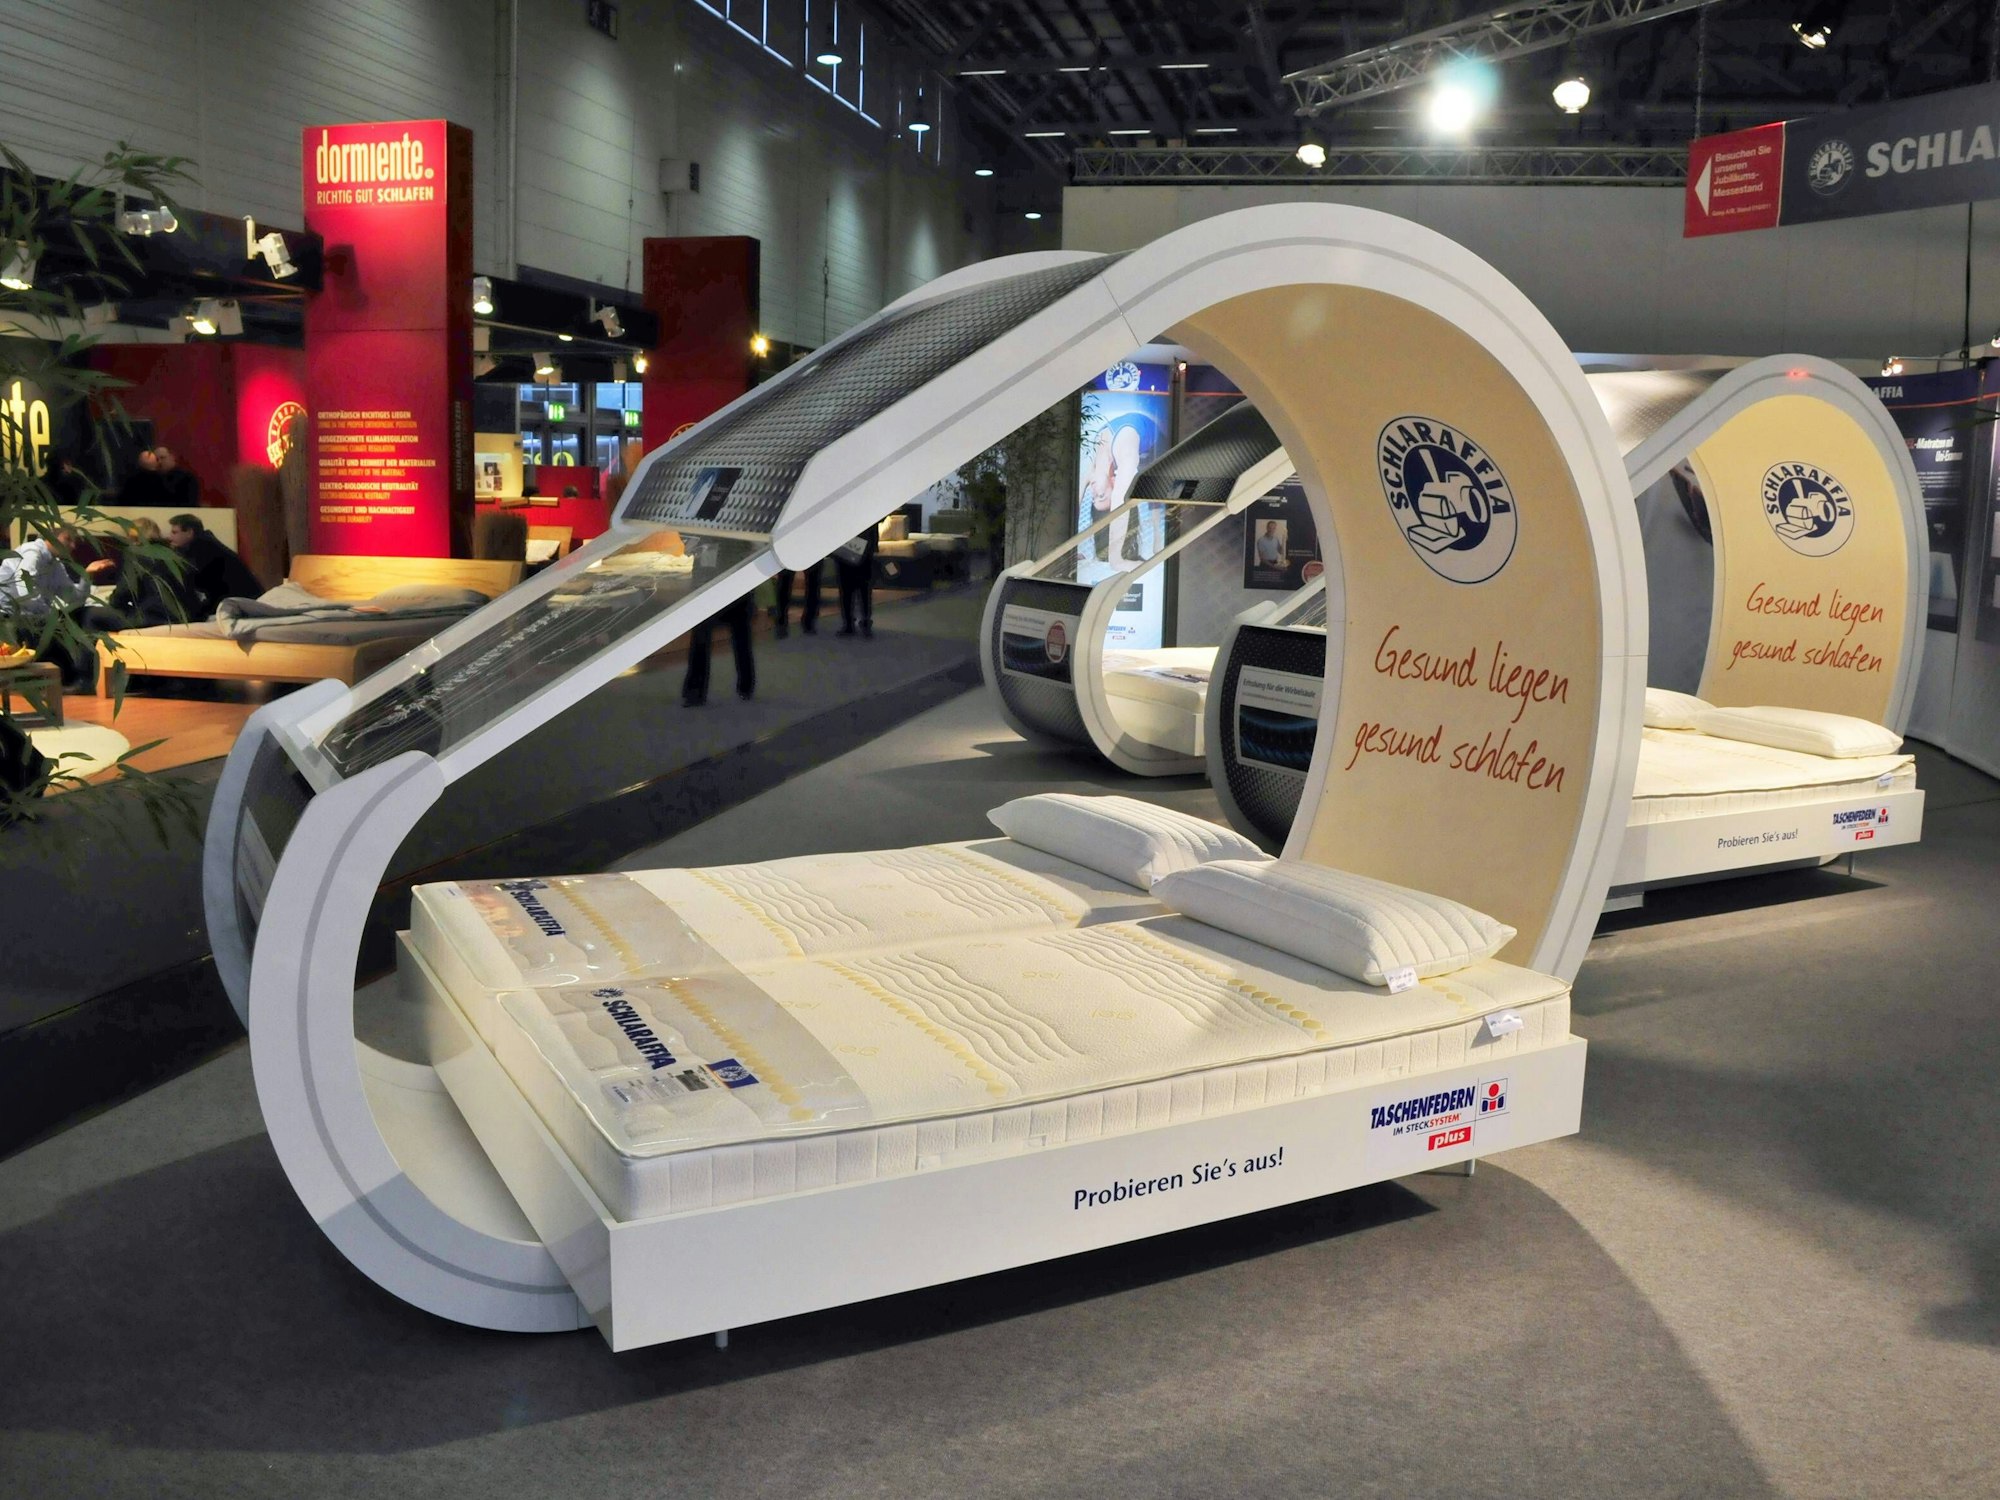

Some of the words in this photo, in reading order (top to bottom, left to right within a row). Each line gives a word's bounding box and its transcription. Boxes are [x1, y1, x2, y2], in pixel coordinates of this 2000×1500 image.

[316, 129, 434, 184] dormiente.
[1714, 162, 1748, 173] unseren
[1715, 148, 1757, 162] Besuchen
[1757, 145, 1772, 156] Sie
[1865, 125, 2000, 178] SCHLA
[317, 190, 352, 204] RICHTIG
[355, 188, 373, 203] GUT
[377, 186, 434, 203] SCHLAFEN
[1713, 171, 1760, 185] Jubiläums-
[1713, 182, 1764, 197] Messestand
[1383, 422, 1511, 515] SCHLARAFFIA
[1764, 464, 1851, 517] SCHLARAFFIA
[1747, 583, 1820, 618] Gesund
[1829, 589, 1883, 635] liegen
[1375, 625, 1477, 687] Gesund
[1489, 641, 1568, 723] liegen
[1727, 639, 1797, 670] gesund
[1803, 639, 1882, 672] schlafen
[1345, 723, 1442, 771] gesund
[1450, 728, 1565, 793] schlafen
[1833, 808, 1877, 825] TASCHENFEDERN
[1718, 834, 1760, 848] Probieren
[1762, 831, 1780, 843] Sie's
[1782, 829, 1798, 841] aus!
[510, 890, 566, 936] SCHLARAFFIA
[602, 1000, 677, 1070] SCHLARAFFIA
[1371, 1086, 1475, 1129] TASCHENFEDERN
[1393, 1127, 1403, 1136] IM
[1406, 1114, 1461, 1133] STECKSYSTEM
[1432, 1129, 1465, 1150] plus
[1074, 1173, 1183, 1210] Probieren
[1191, 1158, 1236, 1184] Sie's
[1243, 1146, 1283, 1173] aus!
